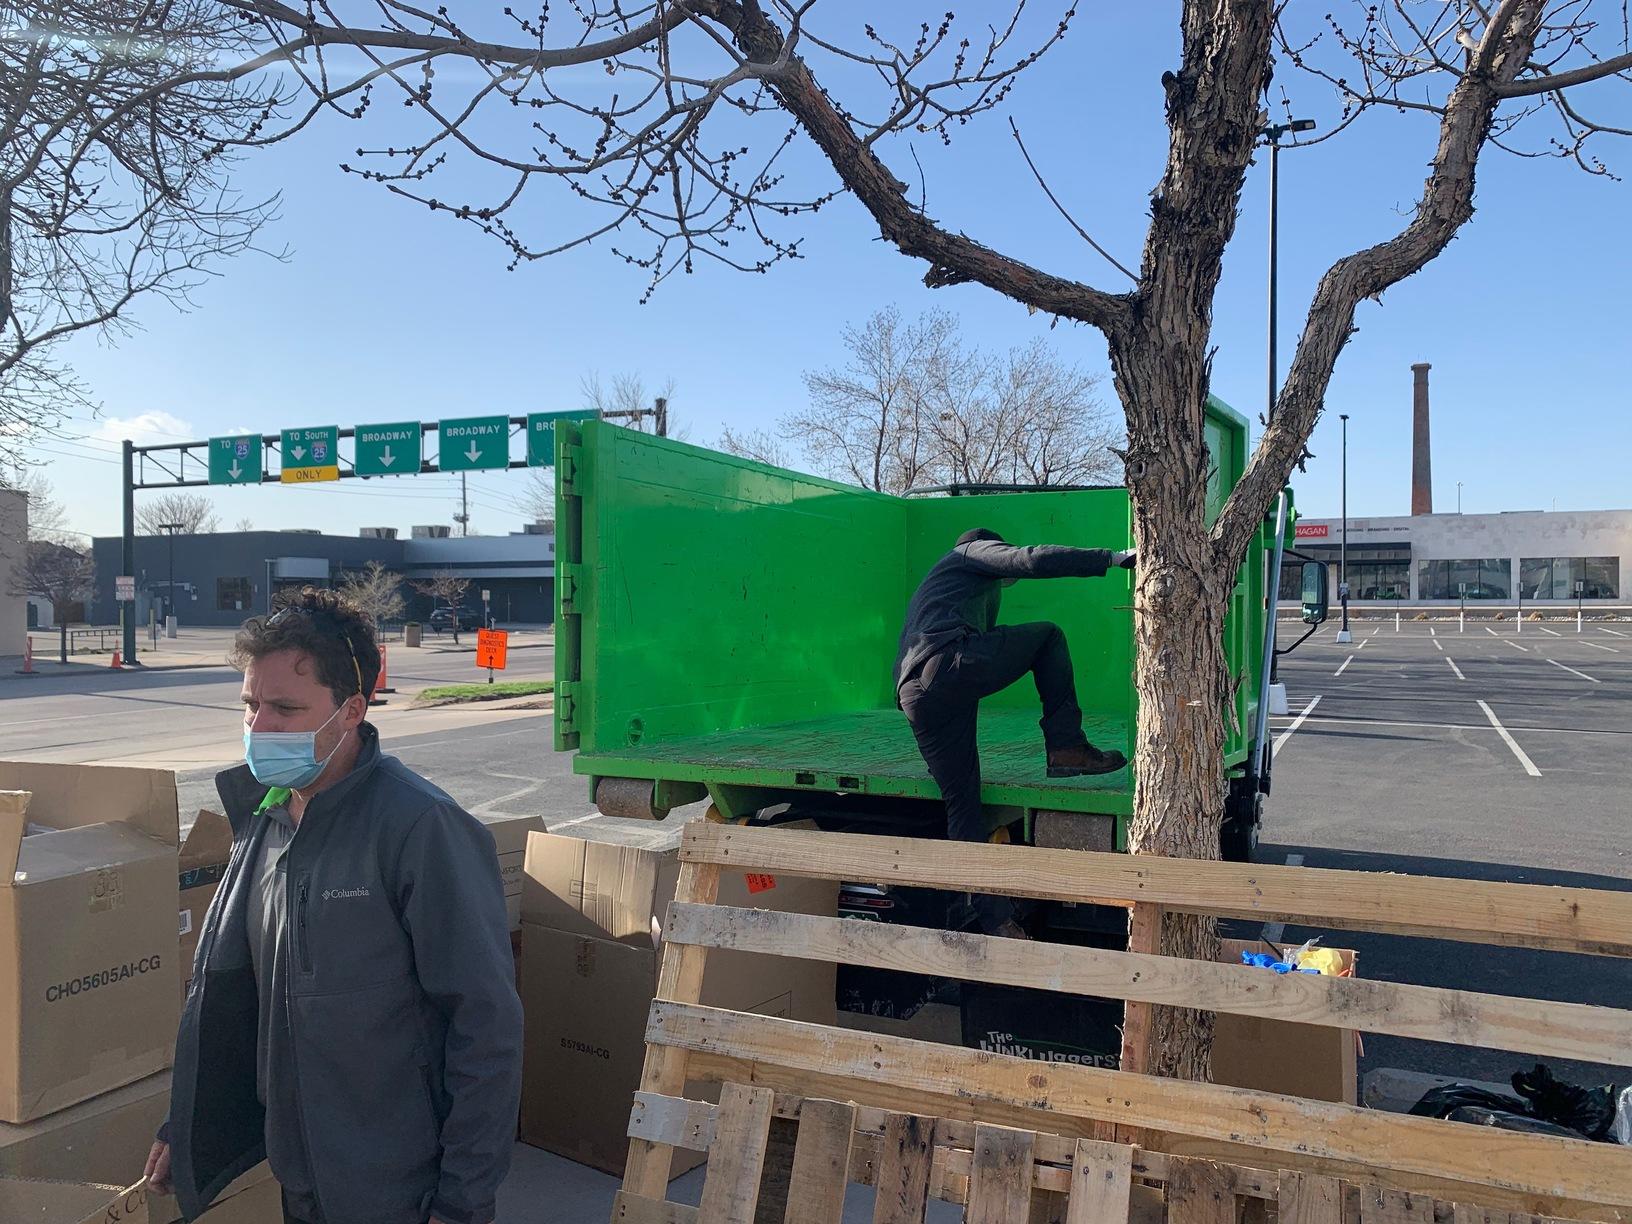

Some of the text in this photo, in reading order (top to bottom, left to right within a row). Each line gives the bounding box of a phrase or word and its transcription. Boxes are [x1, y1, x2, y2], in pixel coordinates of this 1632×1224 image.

[447, 425, 501, 437] BROADWAY
[536, 421, 555, 431] BRO
[289, 430, 329, 441] TO SOUTH
[362, 431, 413, 442] BROADWAY
[220, 440, 231, 449] TO
[236, 446, 248, 456] 25
[313, 447, 325, 458] 25
[296, 469, 322, 480] ONLY
[331, 887, 370, 898] Columbia
[46, 955, 161, 1002] CHO5605AI-CG
